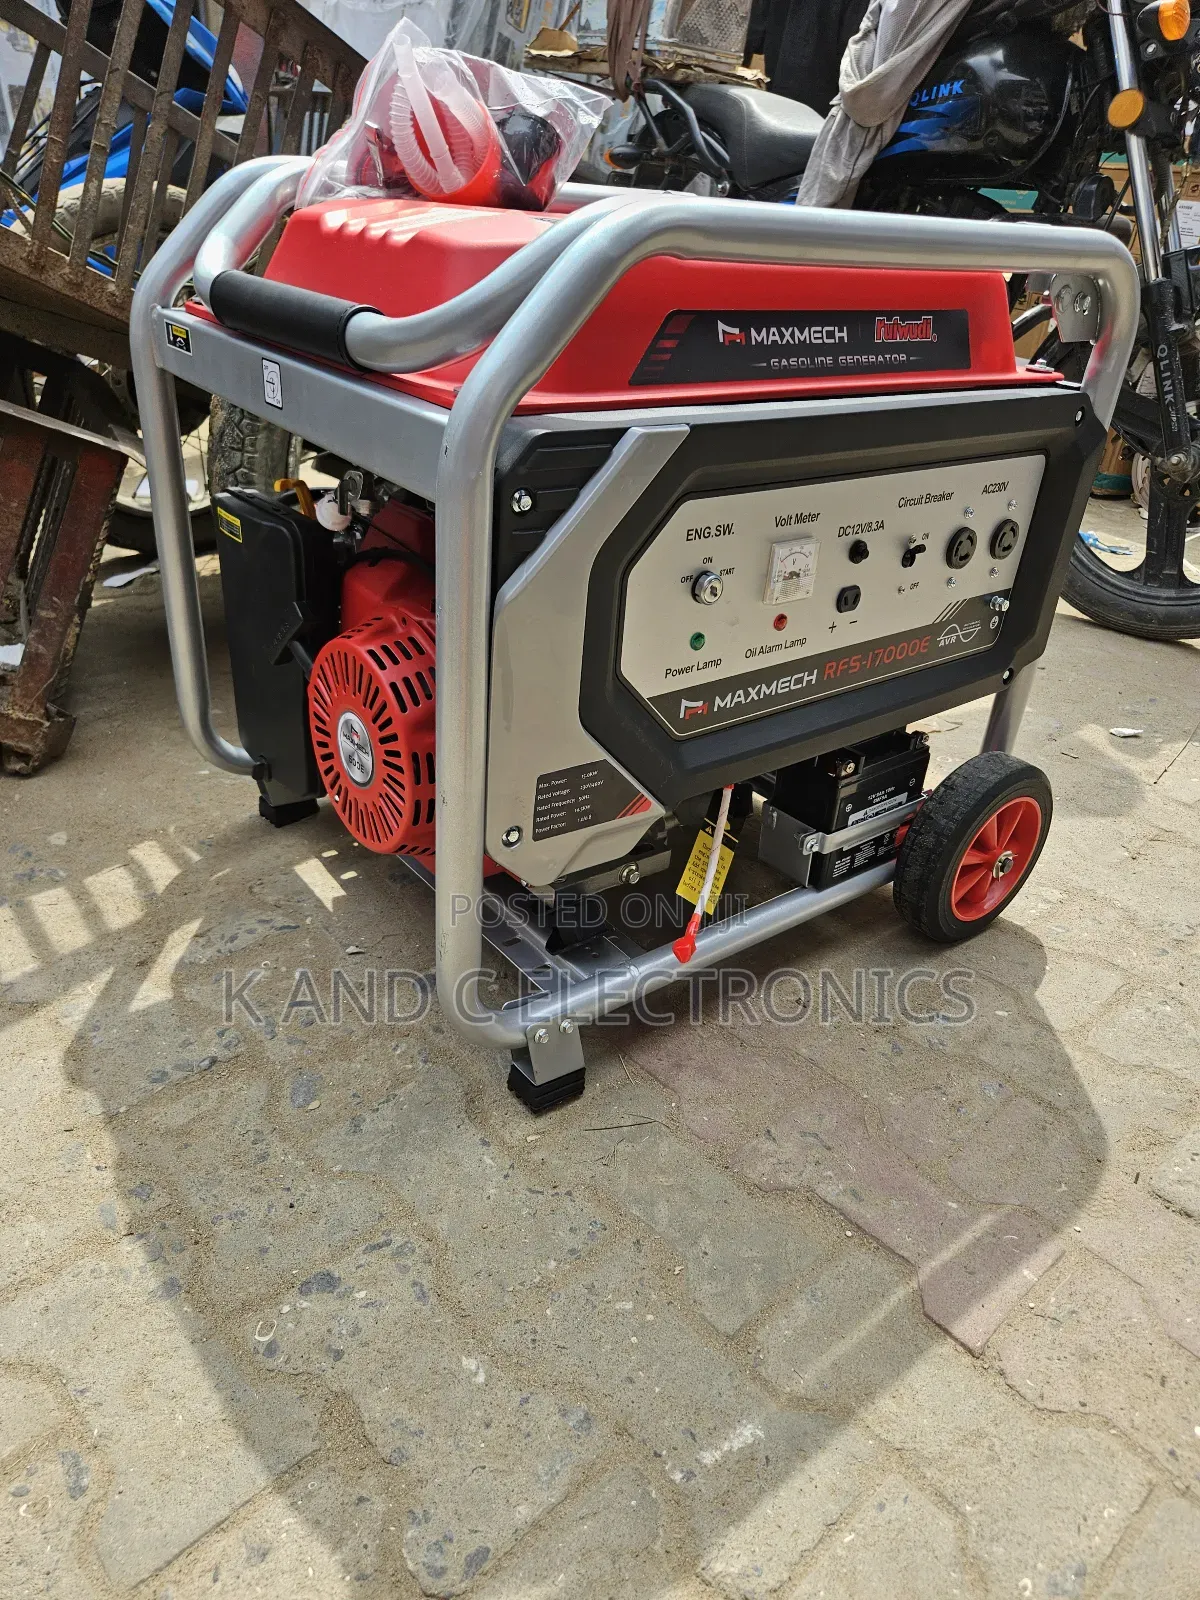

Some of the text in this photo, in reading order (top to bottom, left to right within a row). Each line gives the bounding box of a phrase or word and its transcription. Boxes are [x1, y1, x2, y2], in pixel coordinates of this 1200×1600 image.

[751, 326, 848, 346] MAXMECH
[770, 353, 907, 370] GASOLINE GENERATOR
[1157, 344, 1175, 405] QLINK
[981, 481, 1009, 495] AC230V
[898, 490, 954, 509] Circuit Breaker
[774, 511, 820, 528] Volt Meter
[686, 523, 735, 542] ENG.SW.
[837, 519, 885, 538] DC12V/8.3A
[921, 532, 930, 541] ON
[702, 556, 713, 565] ON
[680, 574, 693, 583] OFF
[719, 567, 735, 577] START
[909, 581, 920, 590] OFF
[744, 636, 807, 659] Oil Alarm Lamp
[938, 635, 957, 647] AVR
[665, 658, 722, 679] Power Lamp
[713, 669, 818, 712] MAXMECH
[535, 814, 550, 823] Rated
[535, 826, 550, 834] Power
